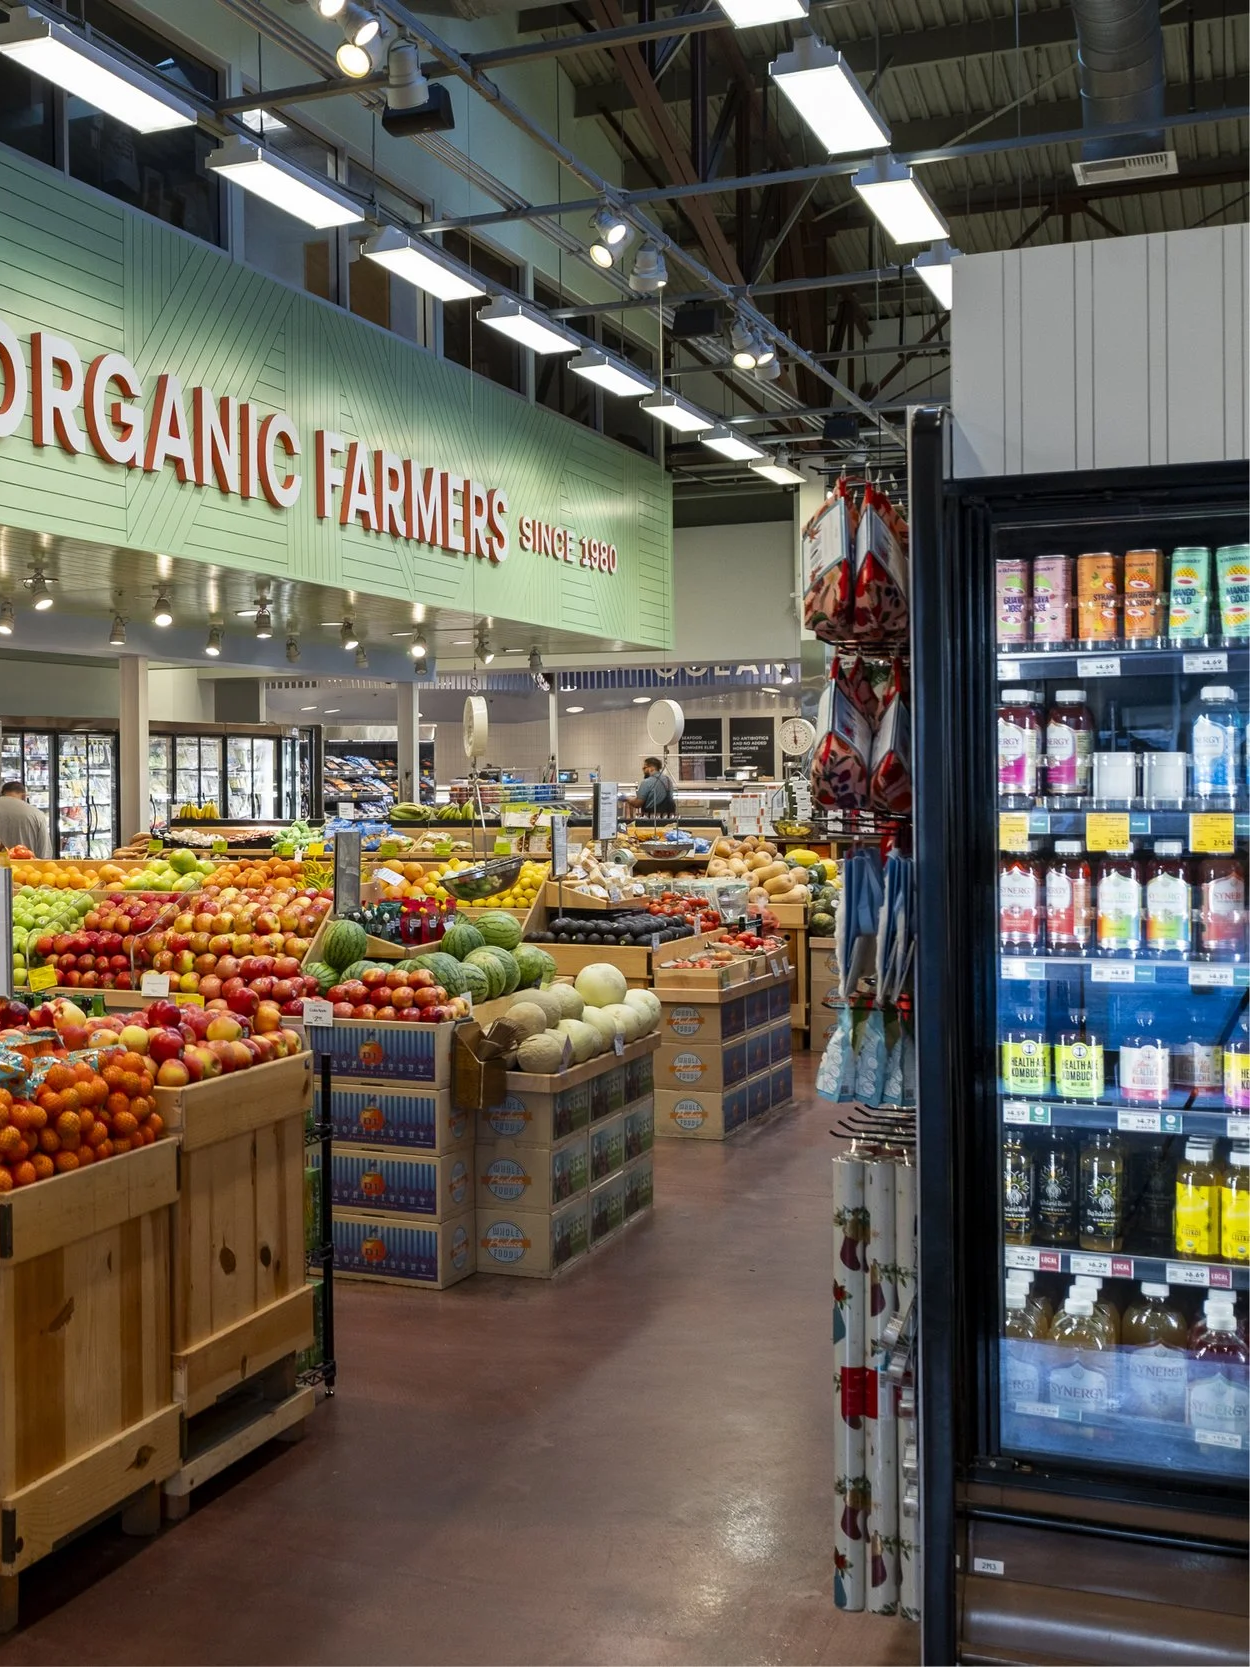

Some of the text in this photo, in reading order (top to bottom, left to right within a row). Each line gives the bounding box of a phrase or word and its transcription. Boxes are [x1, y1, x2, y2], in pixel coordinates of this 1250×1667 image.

[316, 429, 510, 563] FARMERS
[519, 515, 574, 562] SINCE
[580, 535, 618, 575] 1980
[1213, 891, 1242, 900] SYNER
[1011, 1056, 1047, 1067] HEALTH-AE
[1062, 1059, 1098, 1070] HEALTH-AE
[492, 1228, 519, 1238] WHOLE
[488, 1237, 523, 1248] Produce
[1040, 1256, 1057, 1264] LOCAL
[1113, 1263, 1130, 1271] LOCAL
[1211, 1273, 1228, 1281] LOCAL
[1129, 1364, 1183, 1378] SYNERGY
[1051, 1385, 1104, 1399] SYNERGY
[1191, 1400, 1247, 1417] SYNERGY
